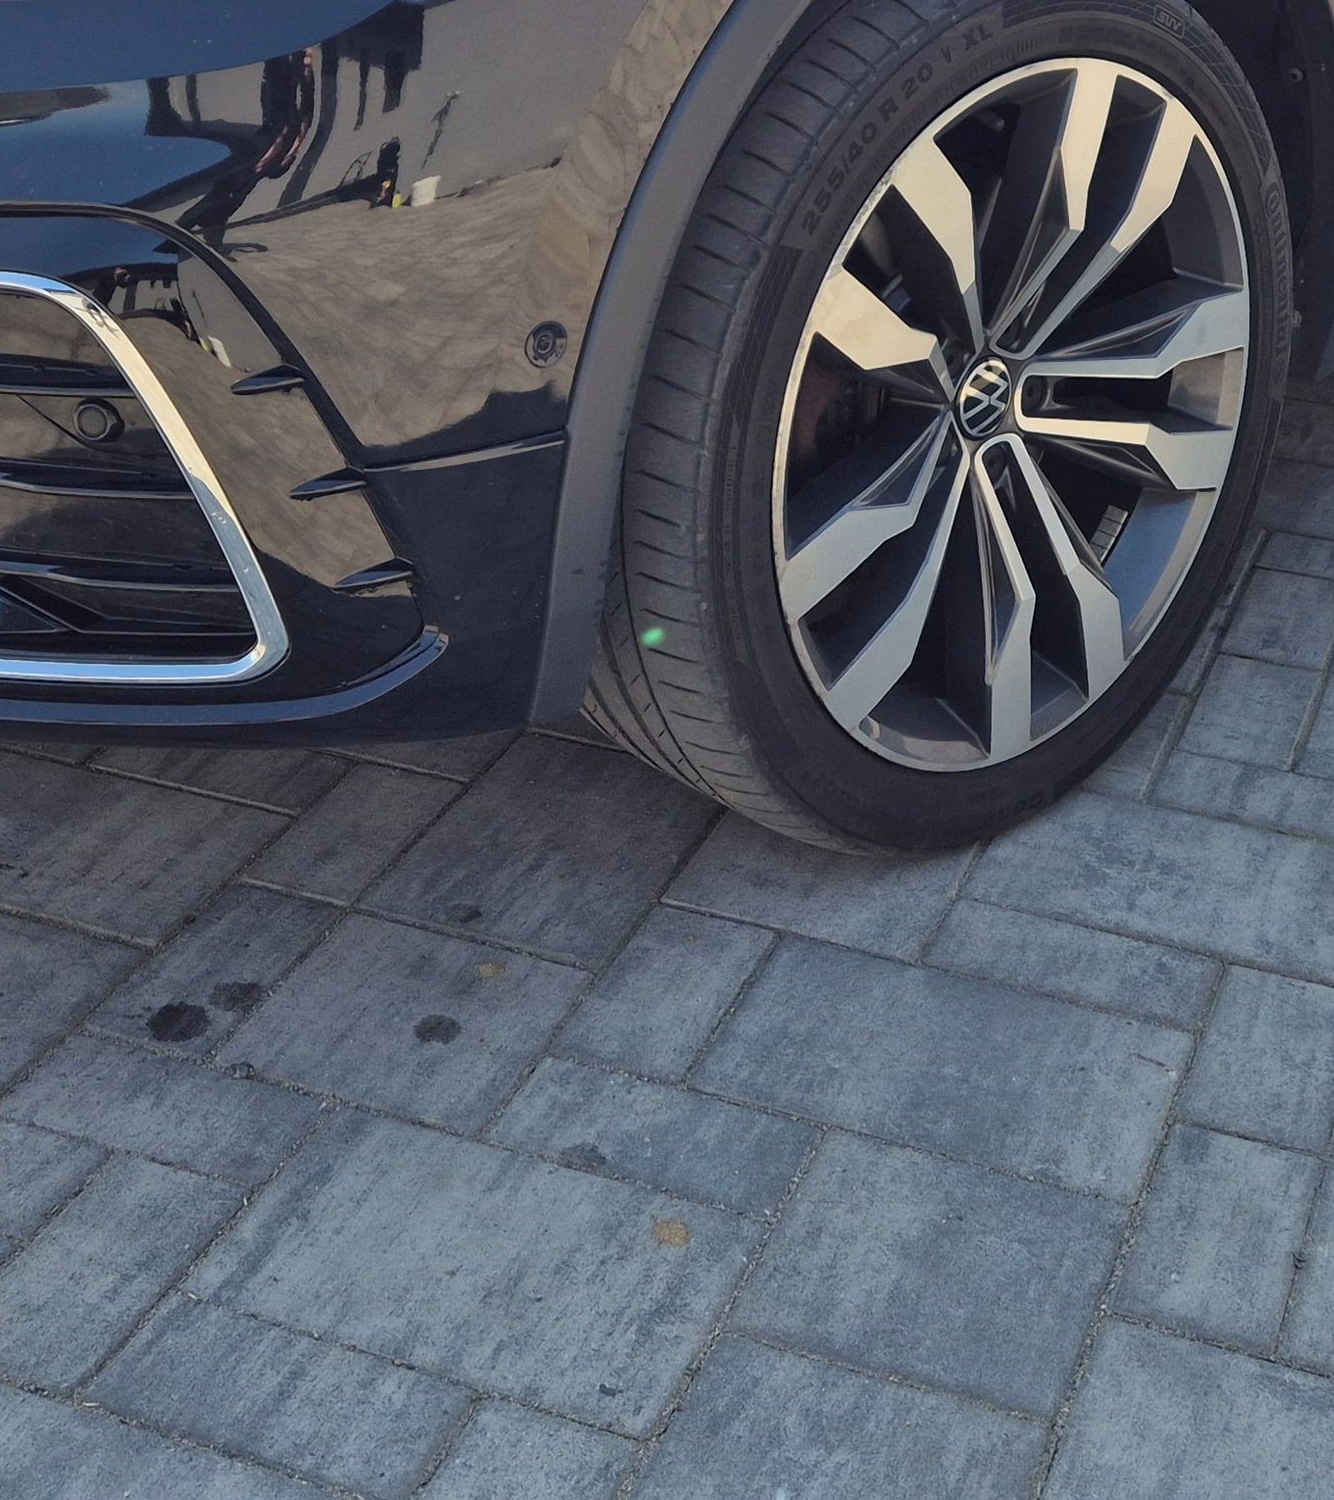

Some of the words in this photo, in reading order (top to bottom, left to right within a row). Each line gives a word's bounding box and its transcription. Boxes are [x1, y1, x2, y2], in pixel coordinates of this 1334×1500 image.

[802, 124, 877, 236] 255/40
[879, 98, 899, 122] R
[902, 62, 933, 99] 20
[961, 23, 994, 47] XL
[1267, 182, 1288, 358] Continental
